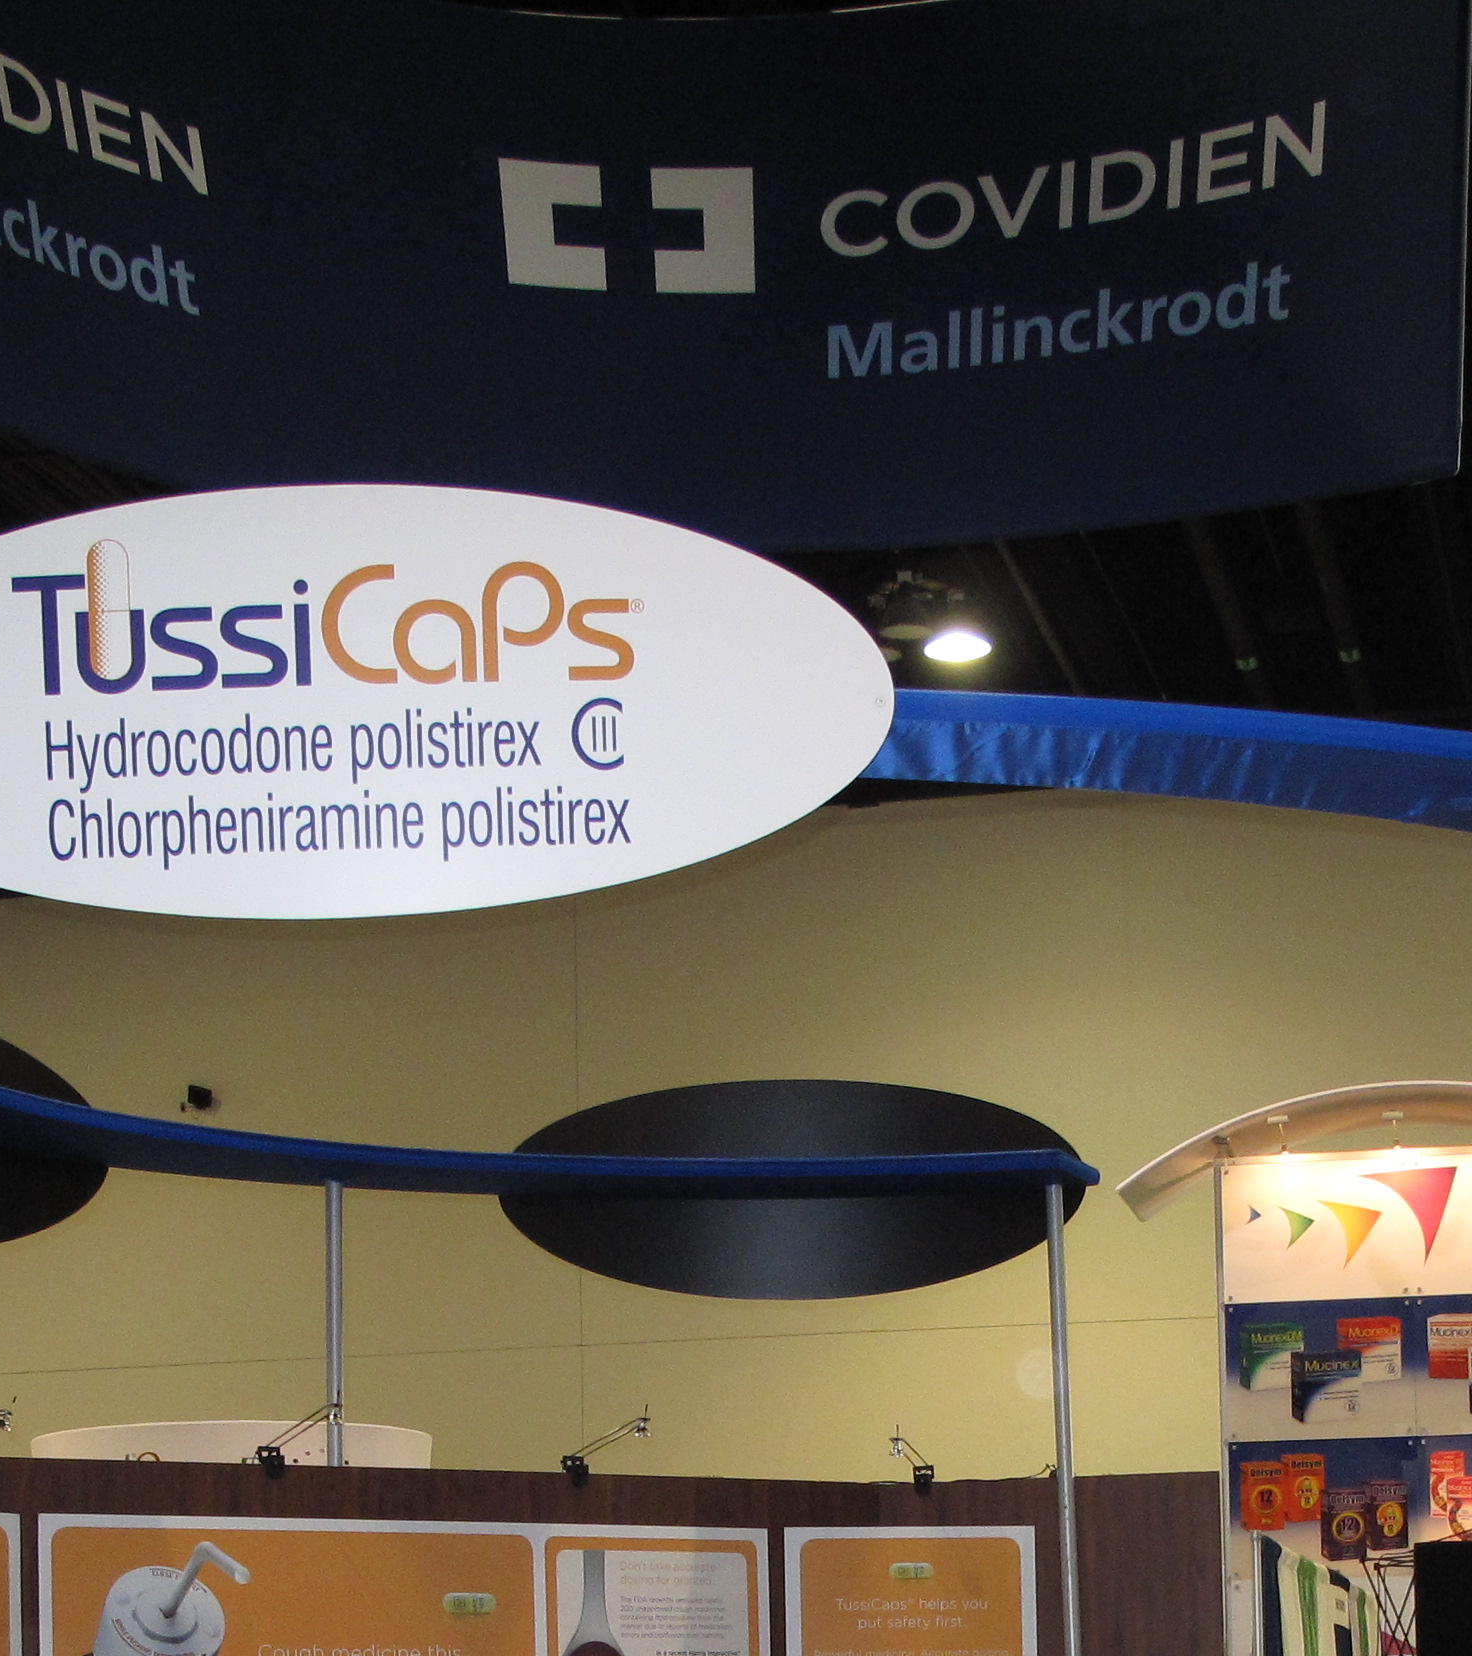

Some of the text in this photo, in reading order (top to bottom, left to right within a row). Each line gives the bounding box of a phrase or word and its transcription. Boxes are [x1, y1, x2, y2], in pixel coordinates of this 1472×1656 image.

[819, 99, 1327, 258] COVIDIEN
[827, 260, 1291, 380] Mallinckrodt
[44, 714, 331, 793] Hydrocodone
[351, 708, 541, 783] polistirex
[48, 787, 631, 870] Chlorpheniramine polistirex
[1304, 1358, 1360, 1372] Mucinex
[1260, 1489, 1273, 1502] 12
[1340, 1517, 1356, 1532] 12
[919, 1598, 958, 1612] helps
[961, 1599, 988, 1612] you
[857, 1616, 882, 1630] put
[887, 1615, 930, 1631] safety
